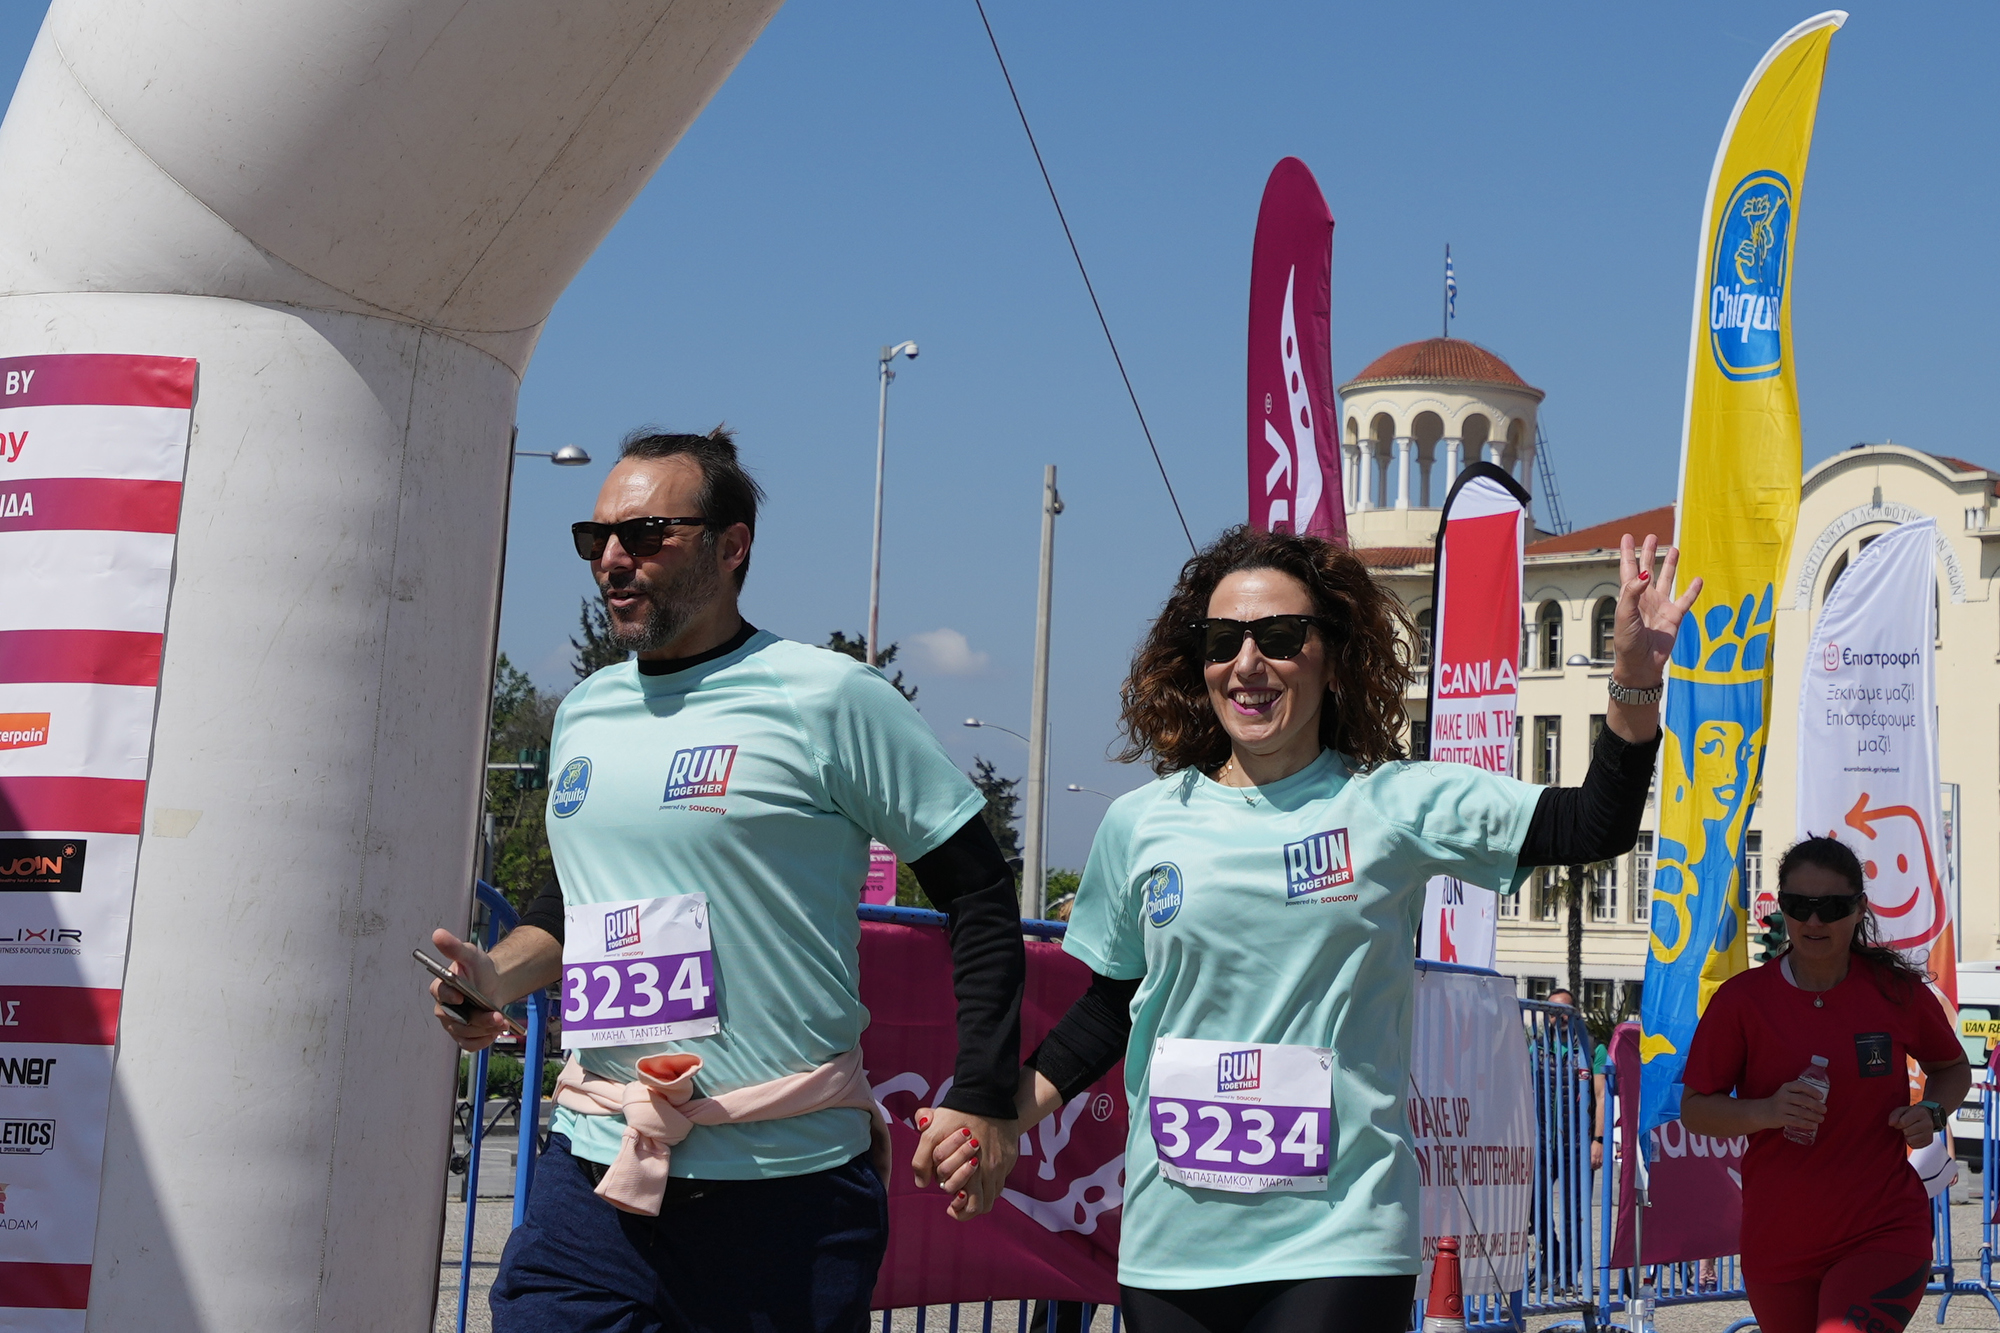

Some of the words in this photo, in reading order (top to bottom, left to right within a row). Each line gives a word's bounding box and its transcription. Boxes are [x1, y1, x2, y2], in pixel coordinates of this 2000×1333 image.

[5, 369, 35, 395] BY
[1826, 683, 1883, 704] Ξεκινάμε
[1886, 683, 1916, 703] μαζί!
[1435, 713, 1463, 741] WAKE
[1492, 709, 1514, 738] TH
[1826, 709, 1917, 731] Επιστρέφουμε
[1858, 735, 1892, 757] μαζί!
[669, 748, 732, 787] RUN
[552, 787, 587, 807] Chiquita
[668, 784, 723, 798] TOGETHER
[688, 804, 727, 815] saucony
[1287, 832, 1348, 882] RUN
[1291, 871, 1350, 894] TOGETHER
[1320, 893, 1359, 904] saucony
[606, 907, 638, 941] RUN
[607, 935, 639, 950] TOGETHER
[564, 956, 710, 1023] 3234
[630, 1024, 673, 1039] ΤΑΝΤΣΗΣ
[1965, 1022, 1986, 1033] VAN
[1220, 1051, 1259, 1083] RUN
[1220, 1080, 1258, 1091] TOGETHER
[1452, 1097, 1470, 1138] UP
[0, 1122, 51, 1146] ETICS
[1156, 1101, 1324, 1167] 3234
[1434, 1146, 1459, 1186] THE
[1180, 1170, 1254, 1187] ΠΑΠΑΣΤΑΜΚΟΥ
